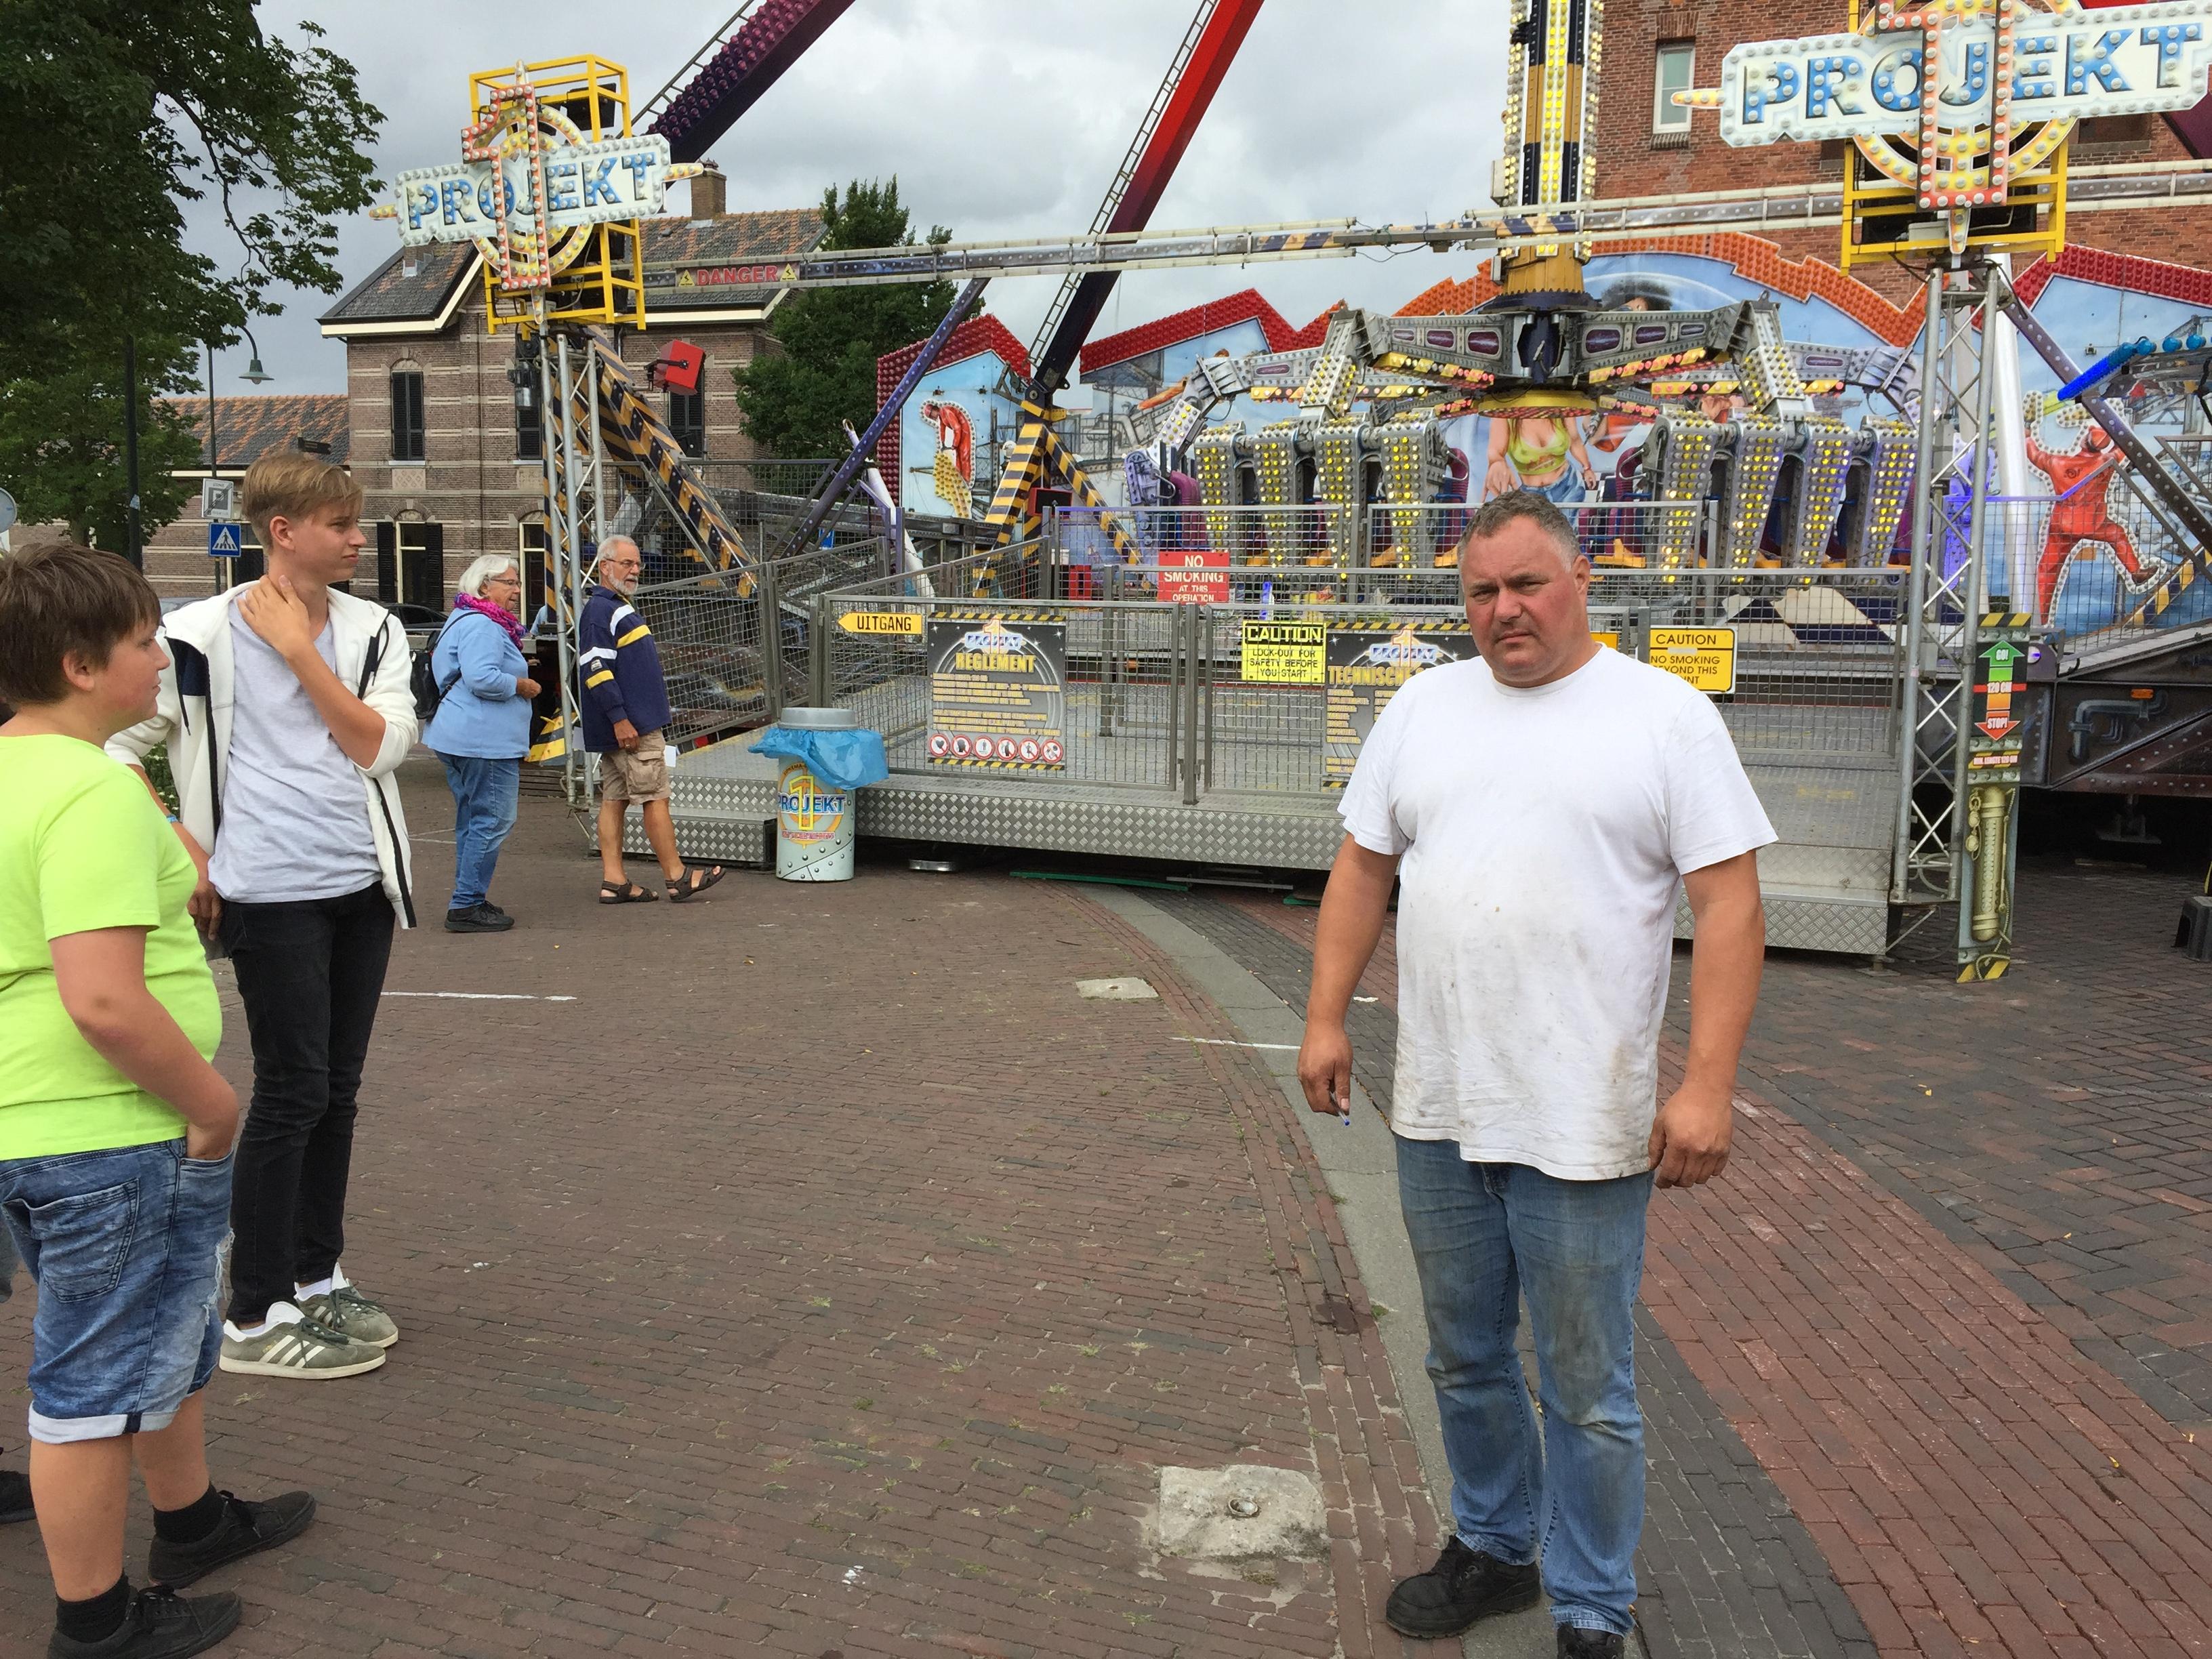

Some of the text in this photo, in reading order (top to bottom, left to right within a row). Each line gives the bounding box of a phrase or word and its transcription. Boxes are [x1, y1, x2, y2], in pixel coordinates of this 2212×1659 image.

[1742, 22, 2203, 125] PROJEKT
[407, 151, 657, 230] PROJEKT
[697, 265, 778, 285] DANGER
[1185, 555, 1204, 568] NO
[1164, 571, 1224, 582] SMOKING
[1172, 594, 1214, 602] OPERATION
[857, 615, 912, 632] UITGANG
[1247, 626, 1322, 643] CAUTION
[1656, 634, 1717, 644] CAUTION
[1252, 649, 1294, 657] LOCK-OUT
[1996, 649, 2009, 661] GO!
[956, 653, 1037, 673] REGLEMENT
[1250, 658, 1317, 668] SAFETY BEFORE
[1651, 655, 1720, 664] NO SMOKING
[1261, 668, 1307, 678] YOU START
[1653, 665, 1718, 674] YOND THIS
[1987, 717, 2008, 730] STOP!
[778, 794, 846, 814] PROJEKT
